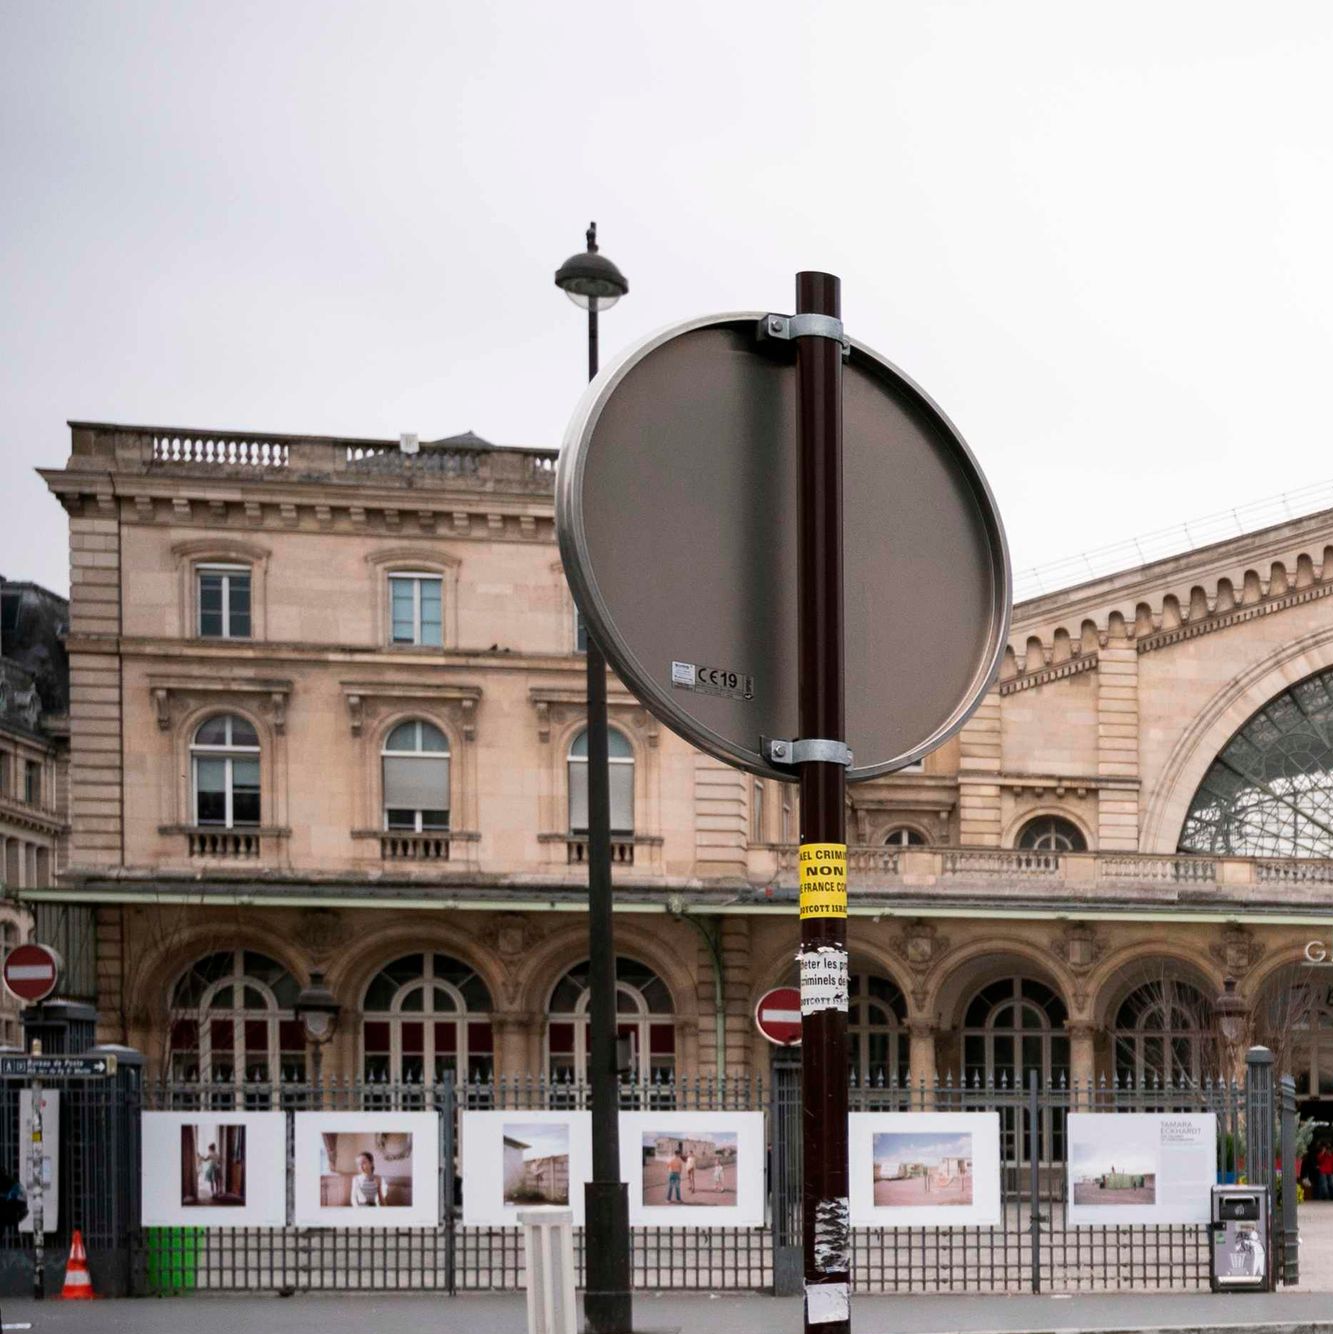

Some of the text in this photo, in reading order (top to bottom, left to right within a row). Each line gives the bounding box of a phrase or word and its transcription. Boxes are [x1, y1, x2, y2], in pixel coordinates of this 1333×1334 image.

[720, 672, 738, 688] 19
[806, 866, 844, 876] NON
[804, 881, 835, 893] FRANCE
[824, 957, 837, 969] les
[1161, 1120, 1193, 1128] TAMARA
[1161, 1127, 1202, 1135] ECKHARDT
